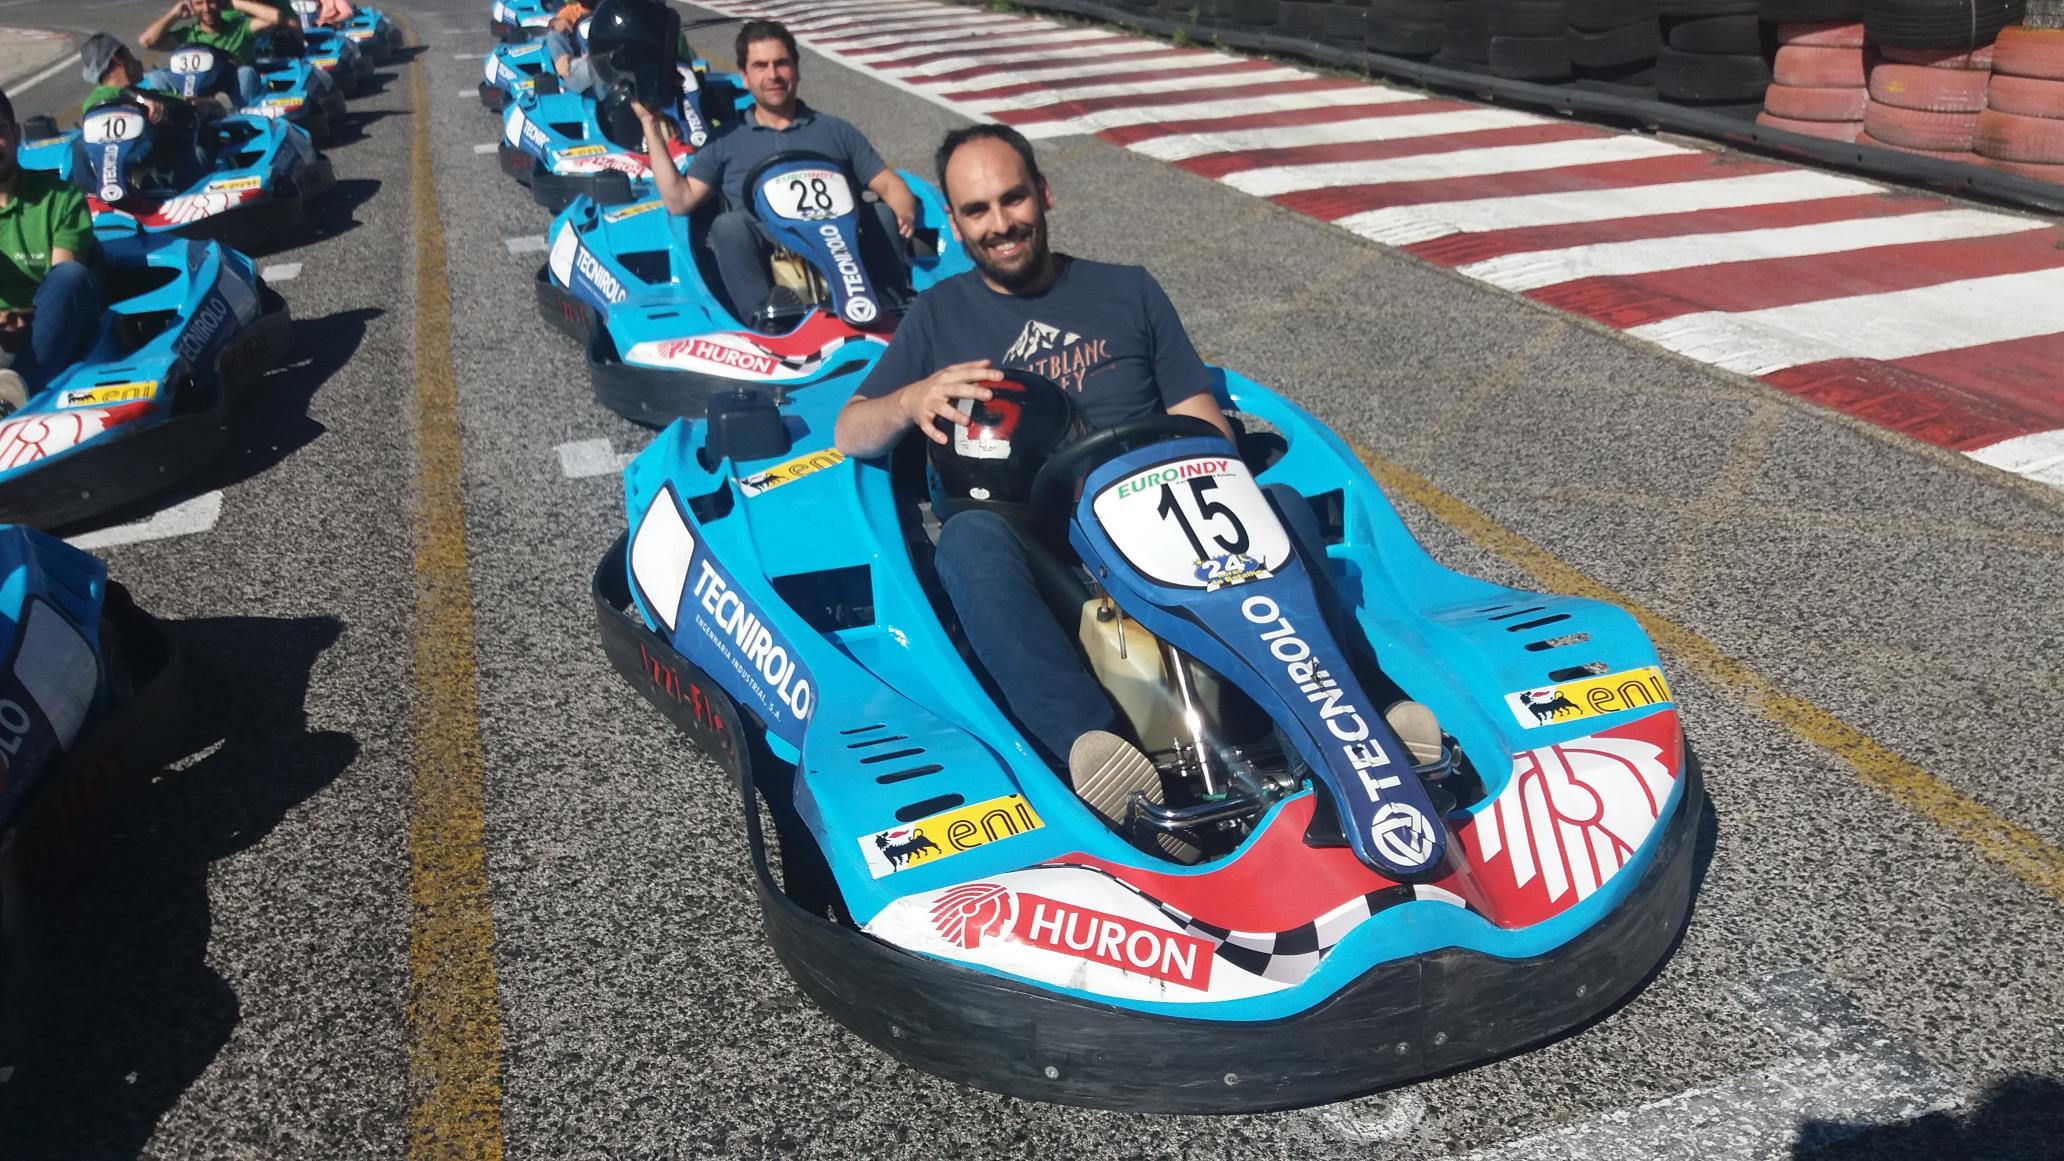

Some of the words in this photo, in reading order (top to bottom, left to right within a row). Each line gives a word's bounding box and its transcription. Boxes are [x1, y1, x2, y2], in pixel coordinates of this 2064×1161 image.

[179, 53, 201, 72] 30
[102, 117, 126, 138] 10
[790, 178, 833, 212] 28
[819, 224, 866, 297] TECNIROLO
[697, 342, 772, 376] HURON
[1117, 460, 1229, 500] EUROINDY
[1157, 475, 1250, 563] 15
[1201, 554, 1246, 579] 24
[693, 559, 810, 721] TECNIROLO
[695, 614, 732, 660] ENGENHARIA
[1241, 595, 1401, 803] TECNIROLO
[1586, 674, 1670, 714] eni
[946, 802, 1036, 852] eni
[1028, 904, 1197, 980] HURON
